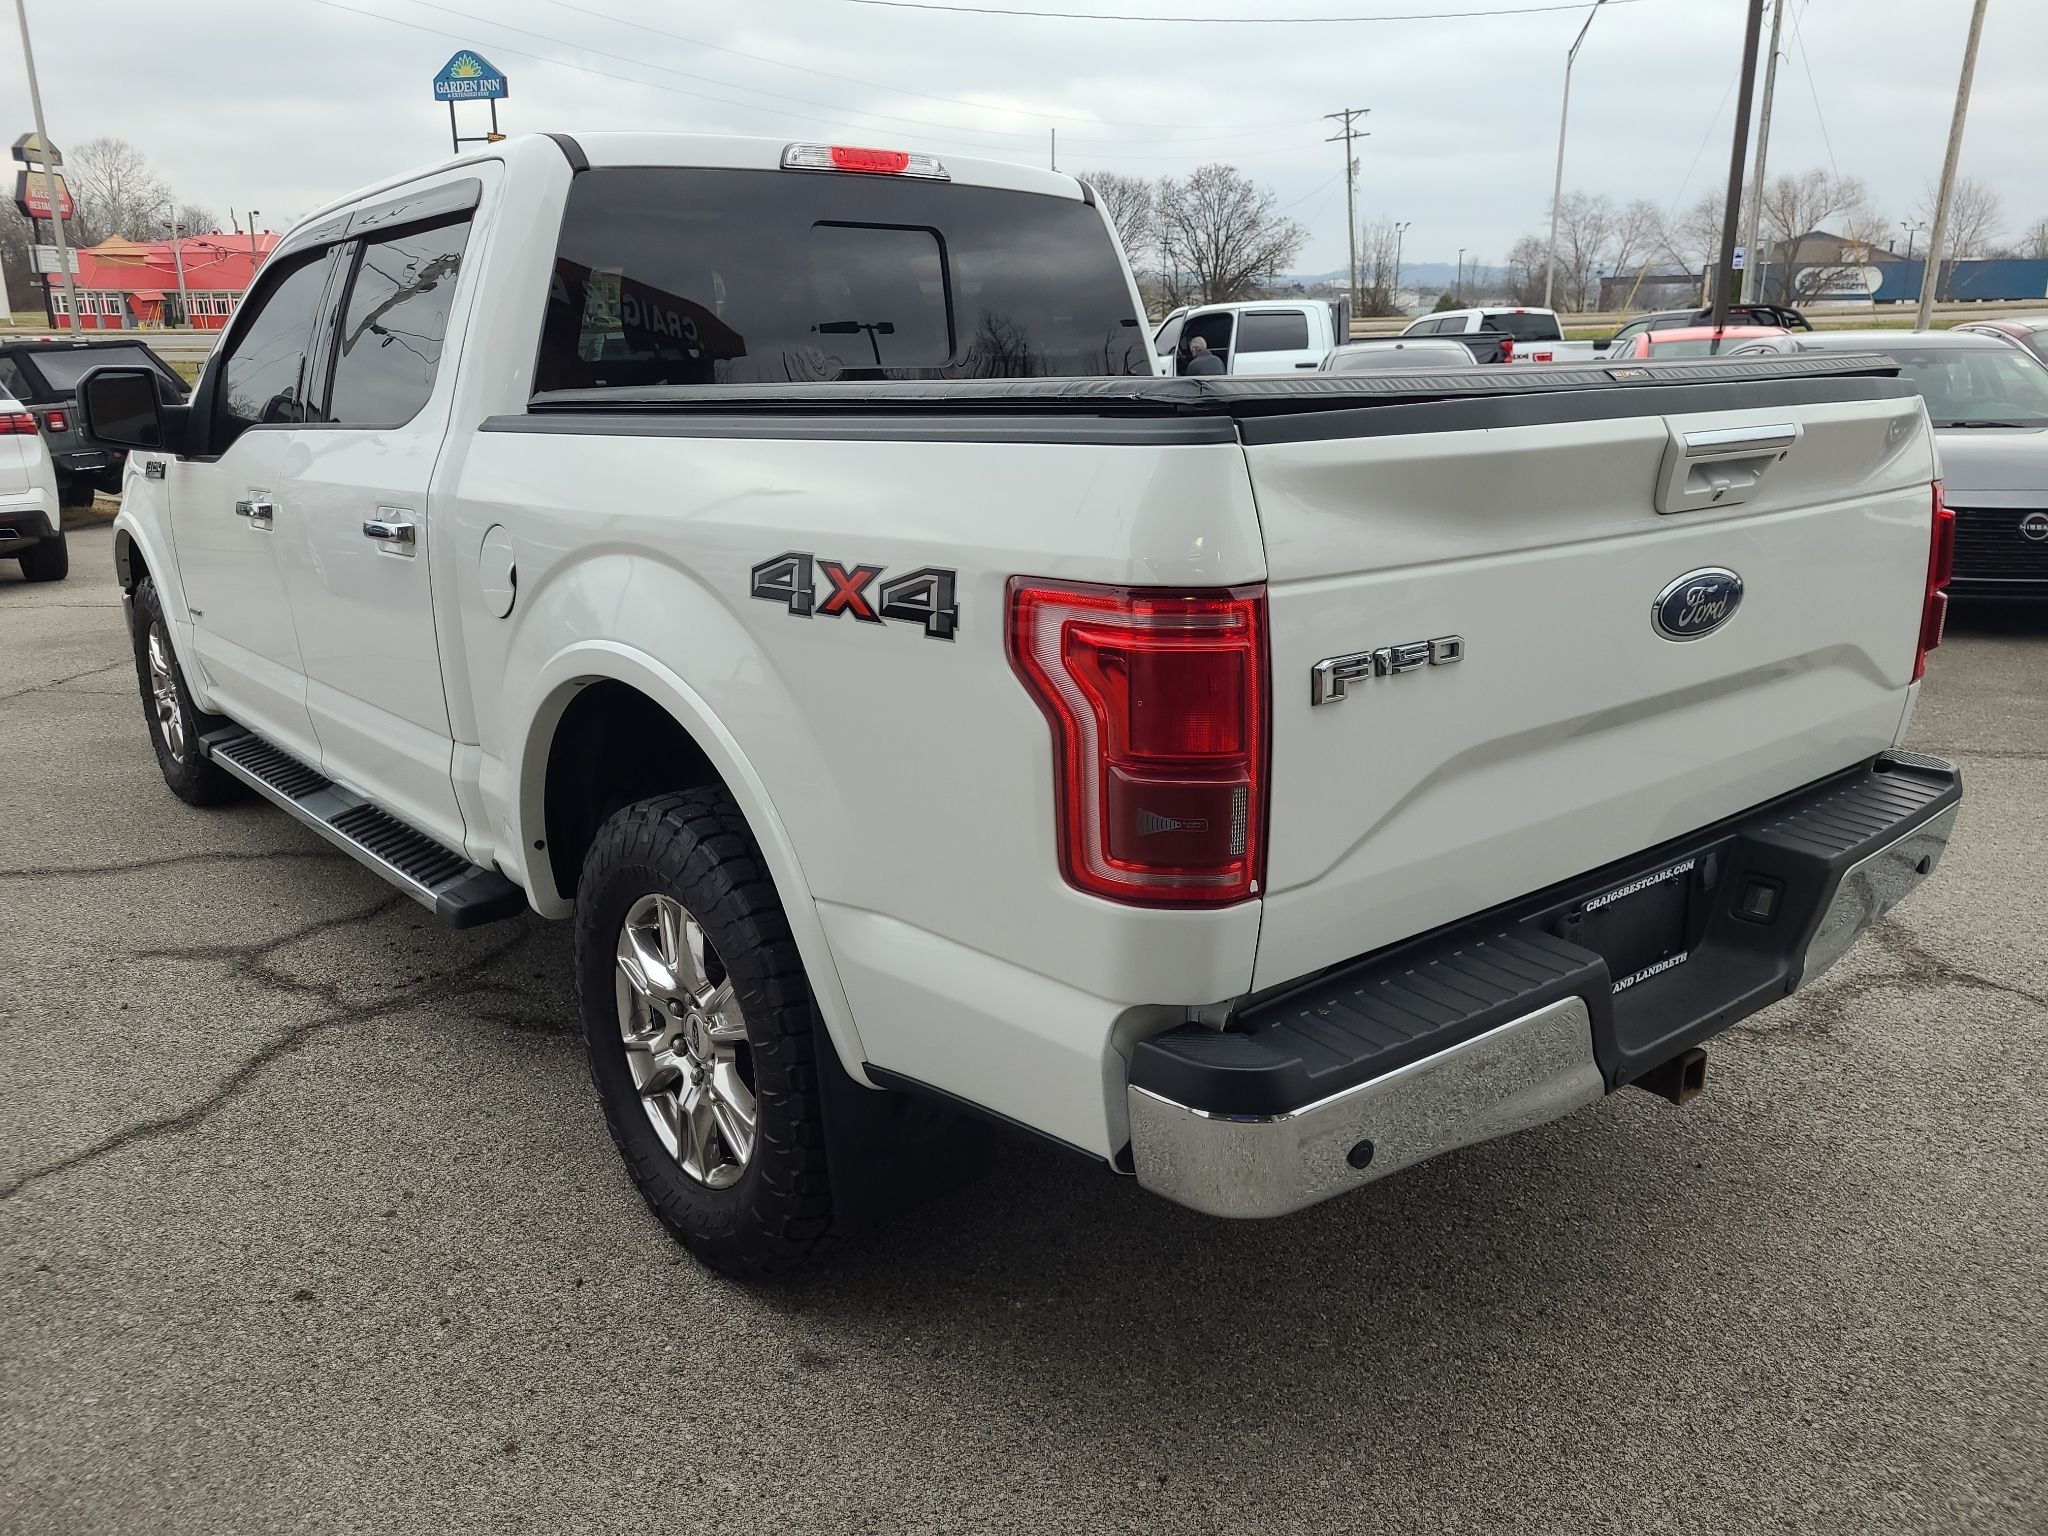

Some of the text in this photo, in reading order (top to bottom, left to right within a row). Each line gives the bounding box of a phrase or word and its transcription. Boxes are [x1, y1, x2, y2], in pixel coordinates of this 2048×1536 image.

[436, 79, 500, 94] GARDEN INN
[29, 200, 69, 213] RESTANT
[1678, 584, 1730, 627] Ford
[1311, 634, 1465, 706] F150
[1586, 860, 1696, 912] CRAIGSBESTCARS.COM
[1612, 951, 1688, 994] AND LANDRETH
